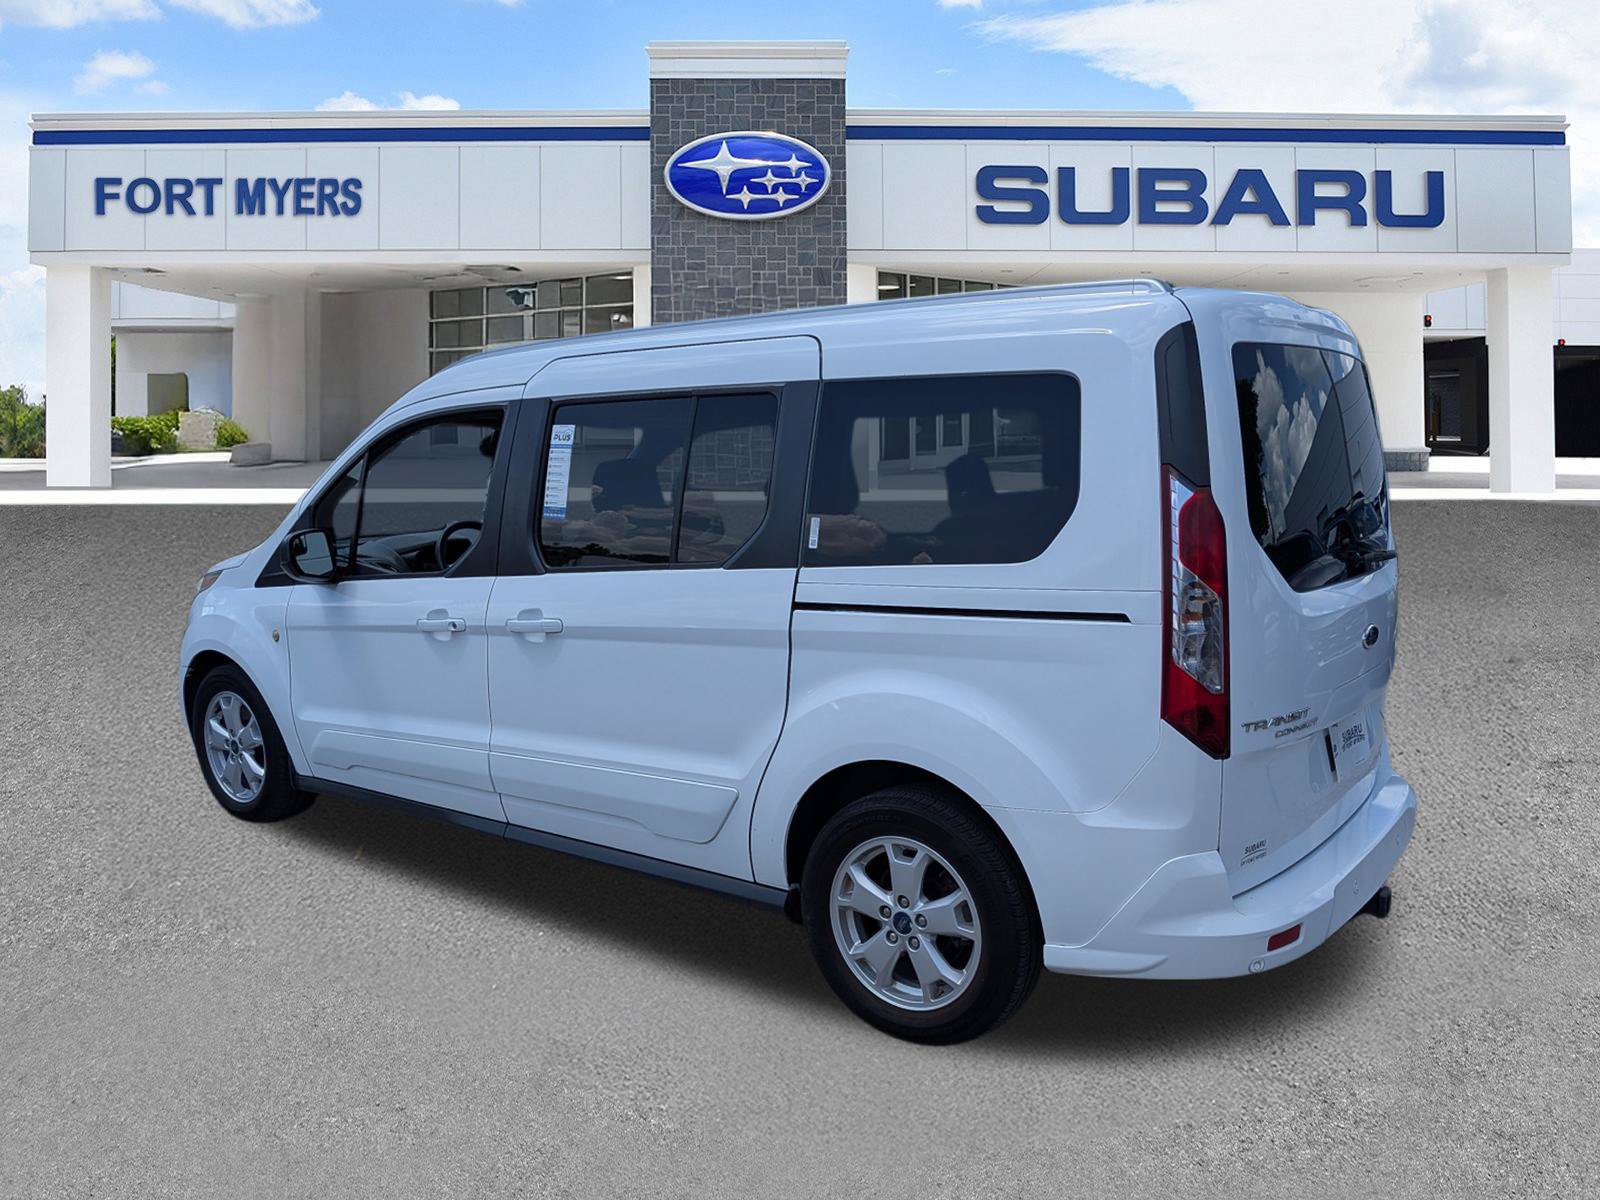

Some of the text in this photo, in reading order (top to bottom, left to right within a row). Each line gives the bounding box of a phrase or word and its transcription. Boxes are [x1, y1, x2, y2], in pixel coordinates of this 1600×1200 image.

[95, 177, 363, 216] FORT MYERS
[975, 165, 1446, 228] SUBARU
[553, 432, 572, 441] PLUS
